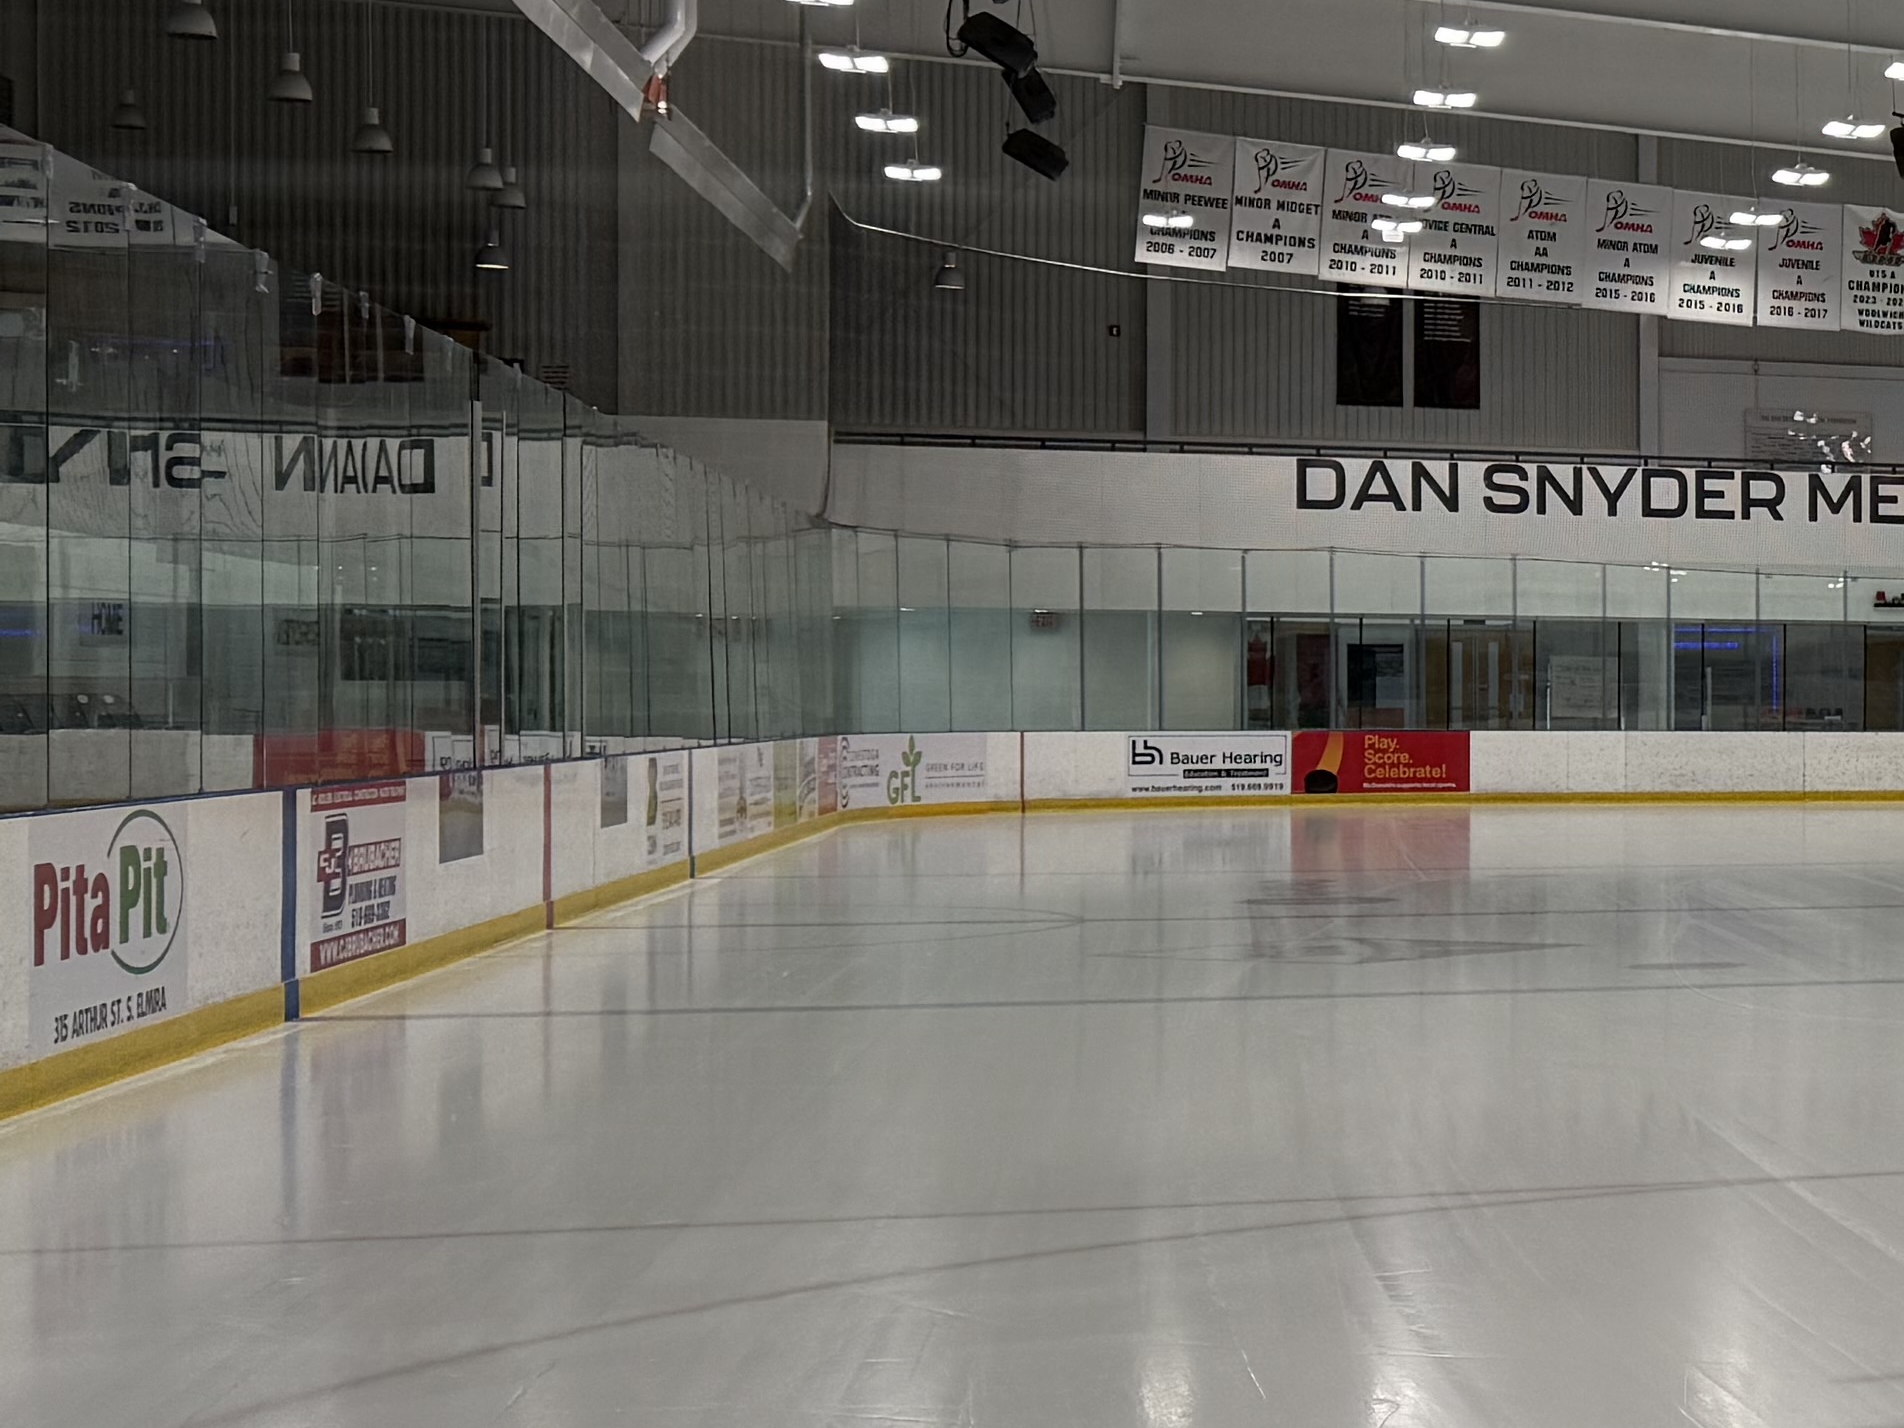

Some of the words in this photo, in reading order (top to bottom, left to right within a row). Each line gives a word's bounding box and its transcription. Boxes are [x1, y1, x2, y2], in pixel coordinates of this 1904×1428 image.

[1171, 173, 1213, 186] OMHA
[1271, 178, 1308, 192] OMHA
[1143, 189, 1180, 204] MINOR
[1184, 194, 1228, 210] PEEWEE
[1235, 196, 1271, 210] MINOR
[1276, 201, 1320, 215] MIDGET
[1441, 201, 1480, 214] OMHA
[1331, 209, 1368, 223] MINOR
[1528, 210, 1567, 222] OMHA
[1272, 218, 1281, 229] A
[1417, 219, 1449, 232] OVICE
[1453, 222, 1496, 236] CENTRAL
[1614, 220, 1653, 234] OMHA
[1150, 228, 1216, 242] CHAMPIONS
[1236, 230, 1316, 249] CHAMPIONS
[1361, 231, 1369, 241] A
[1527, 229, 1557, 242] ATOM
[1450, 238, 1457, 249] A
[1597, 238, 1629, 252] MINOR
[1632, 241, 1658, 255] ATOM
[1786, 239, 1823, 251] OMHA
[1188, 245, 1217, 259] 2007
[1261, 250, 1293, 264] 2007
[1333, 243, 1397, 260] CHAMPIONS
[1534, 246, 1548, 257] AA
[1423, 252, 1483, 268] CHAMPIONS
[1623, 257, 1630, 268] A
[1691, 254, 1736, 267] JUVENILE
[1779, 257, 1821, 270] JUVENILE
[1328, 259, 1356, 272] 2010
[1370, 263, 1396, 276] 2011
[1510, 260, 1572, 276] CHAMPIONS
[1420, 268, 1446, 281] 2010
[1458, 271, 1483, 285] 2011
[1598, 271, 1654, 287] CHAMPIONS
[1709, 271, 1716, 281] A
[1796, 275, 1803, 285] A
[1506, 276, 1533, 289] 2011
[1547, 280, 1573, 292] 2012
[1683, 283, 1741, 298] CHAMPIONS
[1772, 289, 1826, 303] CHAMPIONS
[1678, 298, 1705, 310] 2015
[1804, 308, 1828, 319] 2017
[1858, 308, 1904, 319] WOOLWICH
[1859, 319, 1903, 330] WILDCATS
[1296, 458, 1459, 514] DAN
[1482, 463, 1786, 522] SNYDER
[1364, 735, 1399, 752] Play.
[1170, 751, 1217, 766] Bauer
[1222, 751, 1283, 768] Hearing
[1364, 750, 1413, 764] Score.
[926, 762, 948, 772] GREEN
[951, 762, 964, 772] FOR
[968, 762, 984, 772] LIFE
[1364, 764, 1446, 778] Celebrate!
[887, 766, 922, 805] GFL
[1131, 784, 1222, 793] www.bauerhearing.com
[34, 862, 110, 967] Pita
[119, 844, 169, 945] Pit
[71, 1002, 108, 1040] ARTHUR
[110, 1000, 124, 1028] ST.
[136, 986, 167, 1019] ELMIRA
